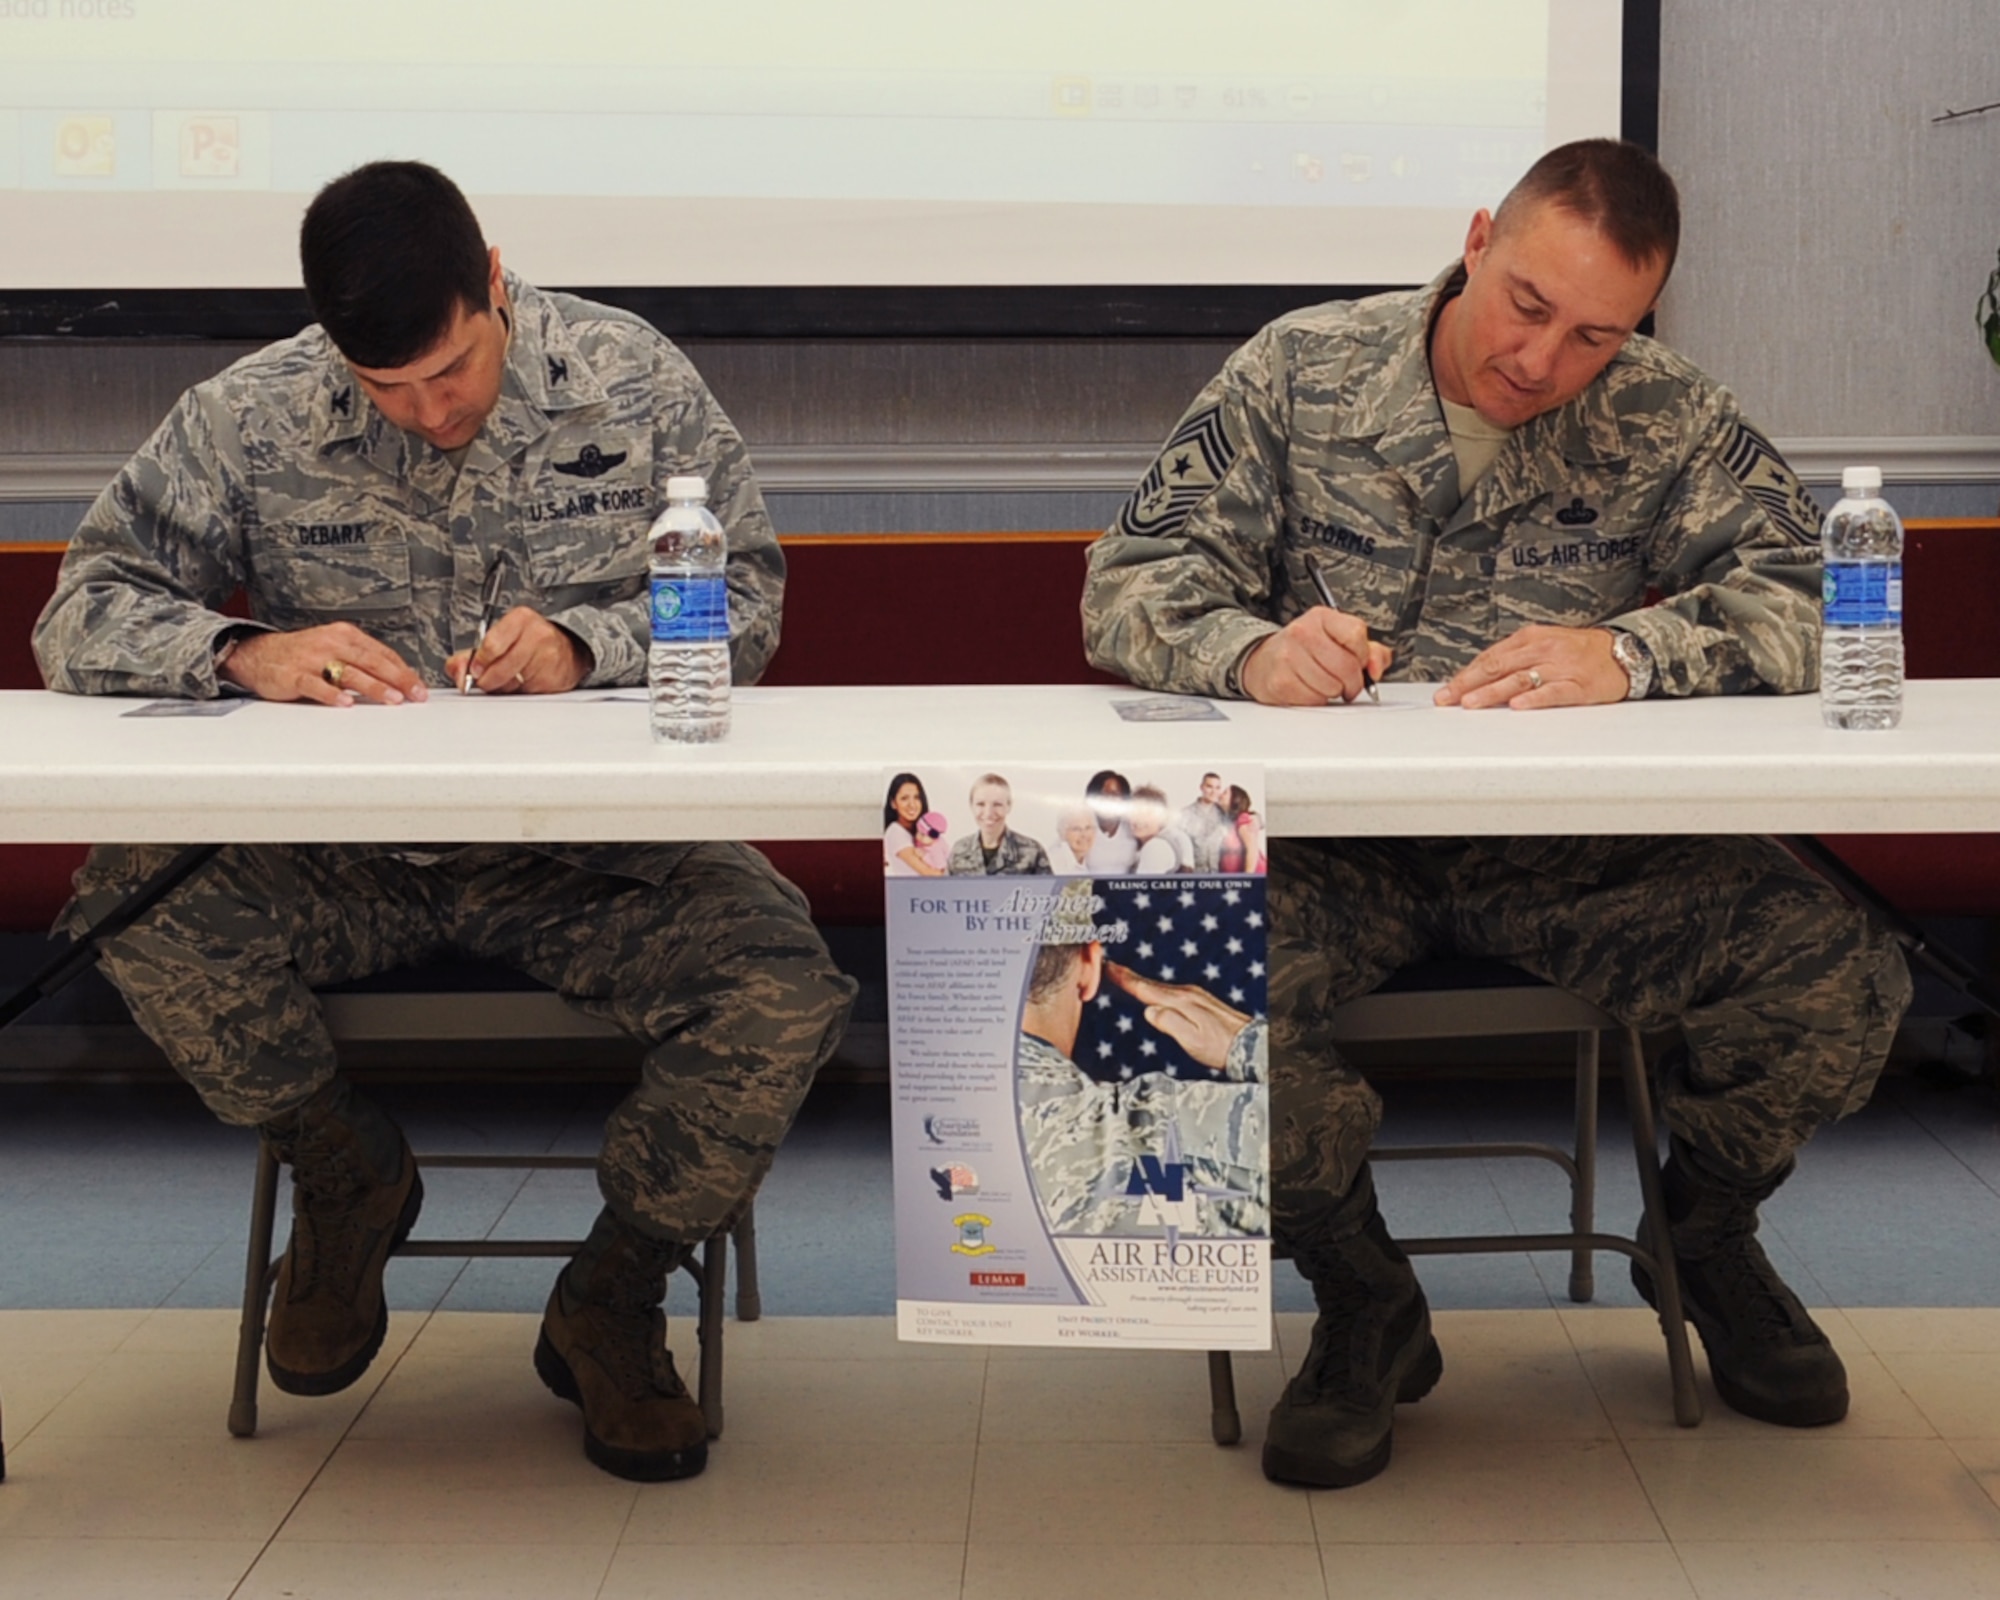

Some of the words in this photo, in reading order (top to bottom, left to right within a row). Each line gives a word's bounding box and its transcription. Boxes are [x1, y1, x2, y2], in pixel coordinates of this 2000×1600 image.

[59, 0, 137, 19] notes
[566, 491, 598, 518] AIR
[601, 487, 646, 512] FORCE
[1301, 516, 1376, 556] STORMS
[1551, 543, 1581, 565] AIR
[1586, 536, 1641, 562] FORCE
[1107, 880, 1149, 890] TAKING
[1151, 880, 1178, 890] CARE
[1181, 880, 1196, 889] OF
[1198, 880, 1223, 889] OUR
[1224, 880, 1252, 889] OWN
[909, 897, 948, 914] FOR
[952, 898, 991, 914] THE
[993, 916, 1032, 932] THE
[1089, 1243, 1144, 1266] AIR
[1154, 1243, 1258, 1267] FORCE
[1087, 1267, 1200, 1284] ASSISTANCE
[1205, 1268, 1260, 1284] FUND
